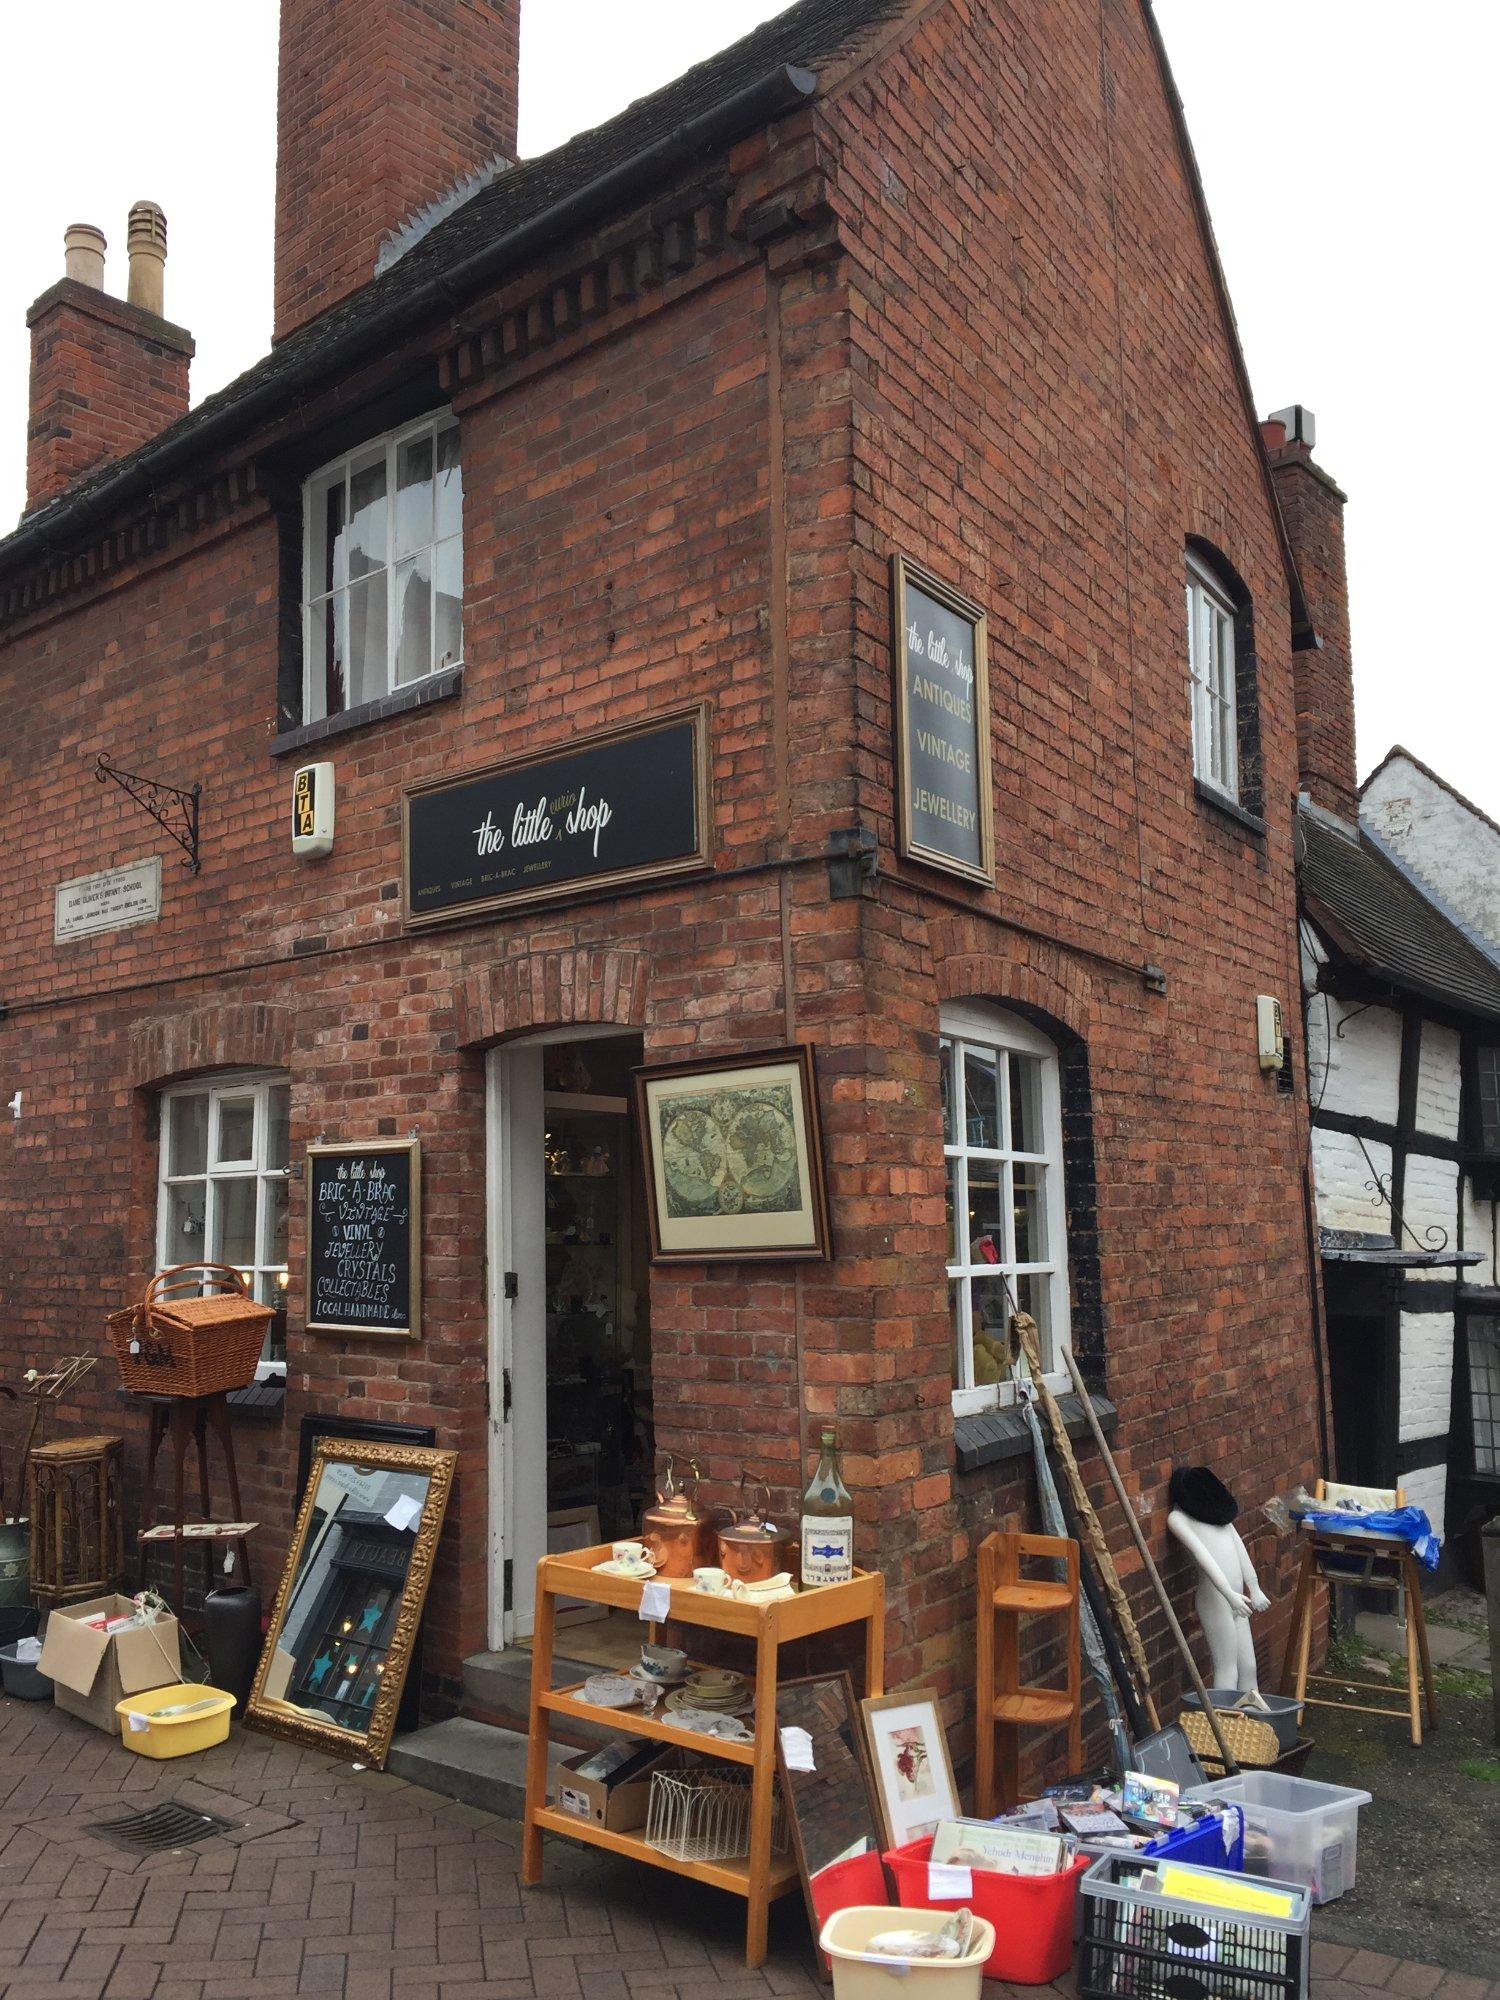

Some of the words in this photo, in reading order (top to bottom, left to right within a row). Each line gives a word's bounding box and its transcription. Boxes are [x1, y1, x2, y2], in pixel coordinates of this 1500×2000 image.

[906, 621, 925, 656] the
[927, 630, 950, 669] little
[954, 649, 974, 700] shop
[912, 674, 972, 724] ANTIQUES
[916, 728, 971, 774] VINTAGE
[297, 774, 313, 832] BTA
[550, 790, 577, 815] curio
[913, 787, 976, 832] JEWELLERY
[472, 811, 505, 856] the
[511, 796, 553, 848] little
[565, 786, 613, 858] shop
[417, 885, 441, 897] ANTIQUES
[451, 877, 473, 889] VINTAGE
[480, 868, 516, 883] BRIC-A-BRAC
[522, 861, 551, 875] JEWELLERY
[68, 898, 81, 908] DAME
[122, 881, 142, 893] SCHOOL
[336, 1163, 349, 1180] the
[350, 1161, 366, 1180] little
[370, 1160, 386, 1187] shop
[339, 1202, 394, 1225] VINTAGE
[343, 1223, 373, 1241] VINYL
[324, 1240, 384, 1262] JEWELLERY
[337, 1259, 396, 1284] CRYSTALS
[316, 1276, 390, 1303] COLLECTABLES
[315, 1299, 343, 1316] LOCAL
[343, 1302, 390, 1319] HANDMADE
[805, 1574, 848, 1583] MARTELL
[982, 1844, 1012, 1858] Yehudi
[1015, 1849, 1054, 1864] Menuhin
